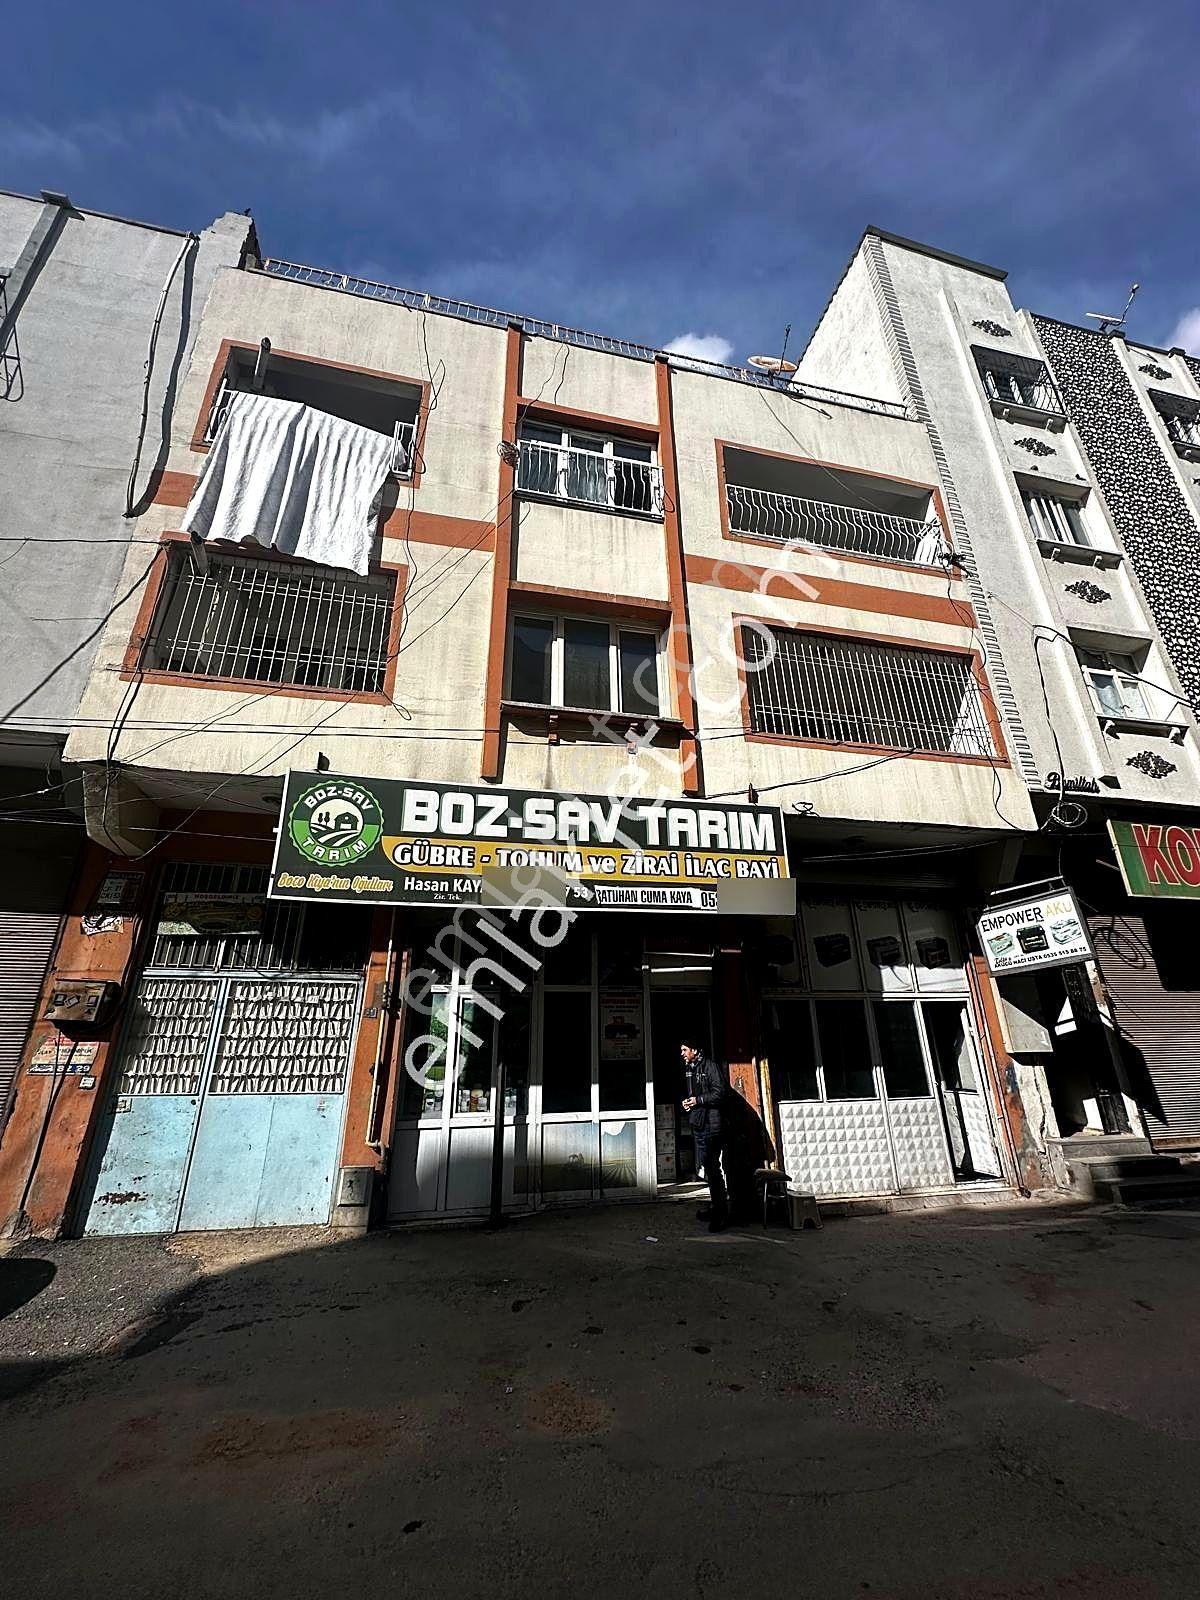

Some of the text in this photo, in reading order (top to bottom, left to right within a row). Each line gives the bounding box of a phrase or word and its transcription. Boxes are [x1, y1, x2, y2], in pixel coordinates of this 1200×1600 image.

[304, 786, 374, 811] BOZ-SAV
[400, 788, 777, 852] BOZ-SAV TARIM
[300, 836, 368, 862] TARIM
[392, 839, 475, 867] GÜBRE
[496, 847, 583, 874] TOHUM
[588, 855, 616, 875] ve
[735, 857, 780, 879] BAYİ
[1131, 823, 1200, 887] KO
[404, 876, 449, 892] Hasan
[640, 890, 668, 904] CUMA
[670, 891, 693, 904] KAYA
[701, 891, 718, 908] 05
[981, 907, 1044, 932] EMPOWER
